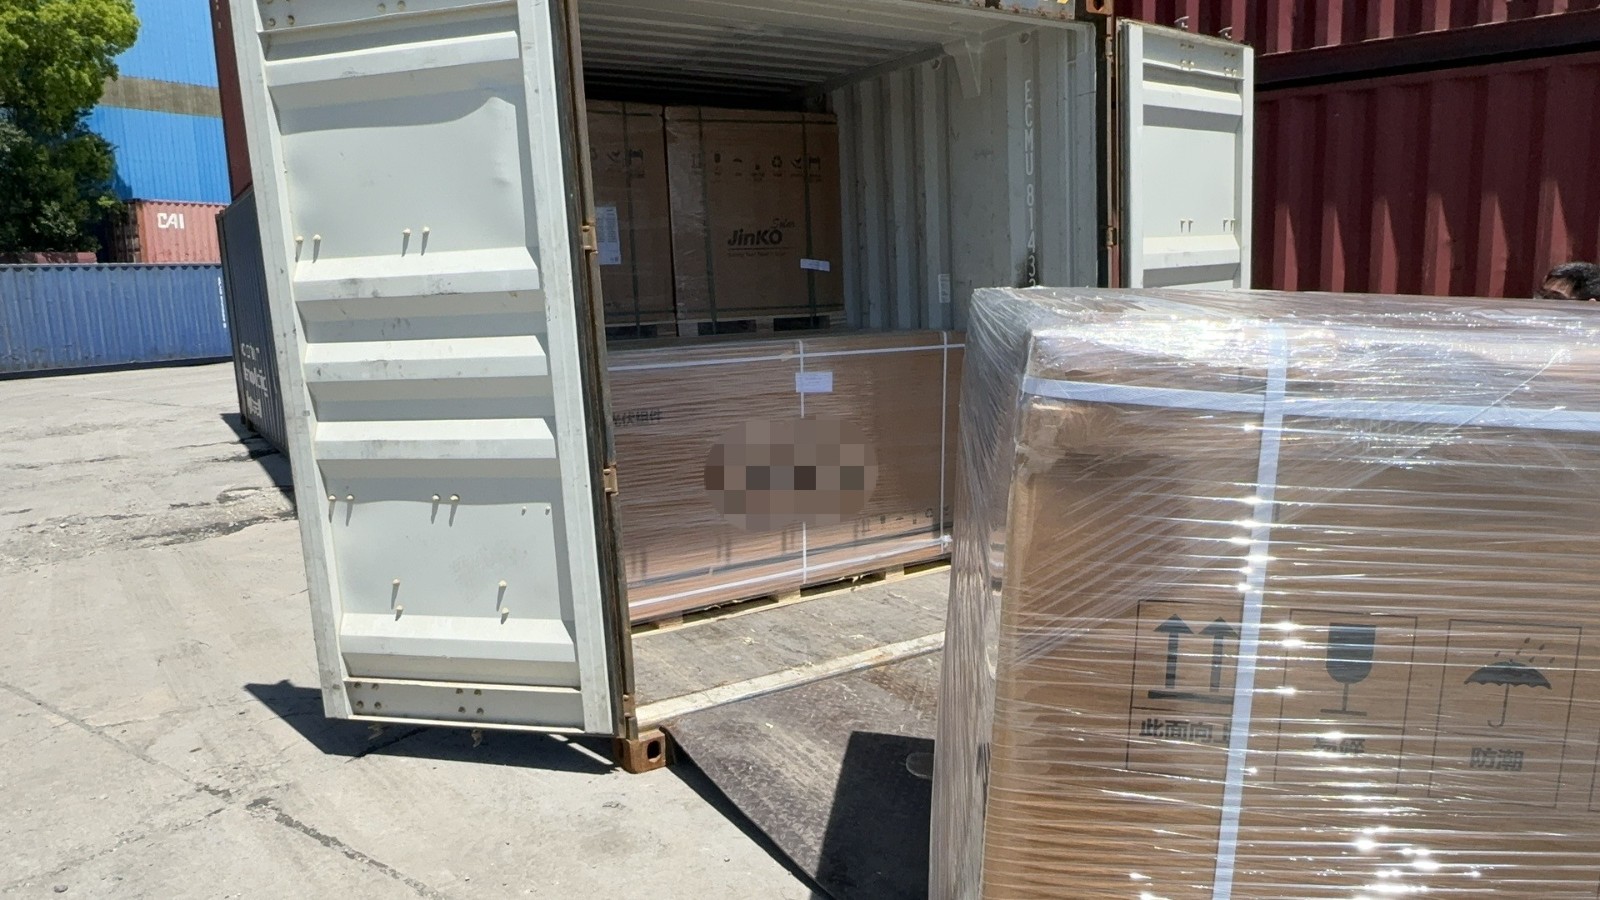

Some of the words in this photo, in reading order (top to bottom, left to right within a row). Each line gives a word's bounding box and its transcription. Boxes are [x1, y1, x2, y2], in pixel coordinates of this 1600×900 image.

[1024, 79, 1035, 176] ECMU
[156, 212, 185, 229] CAI
[1469, 747, 1524, 772] 防潮
